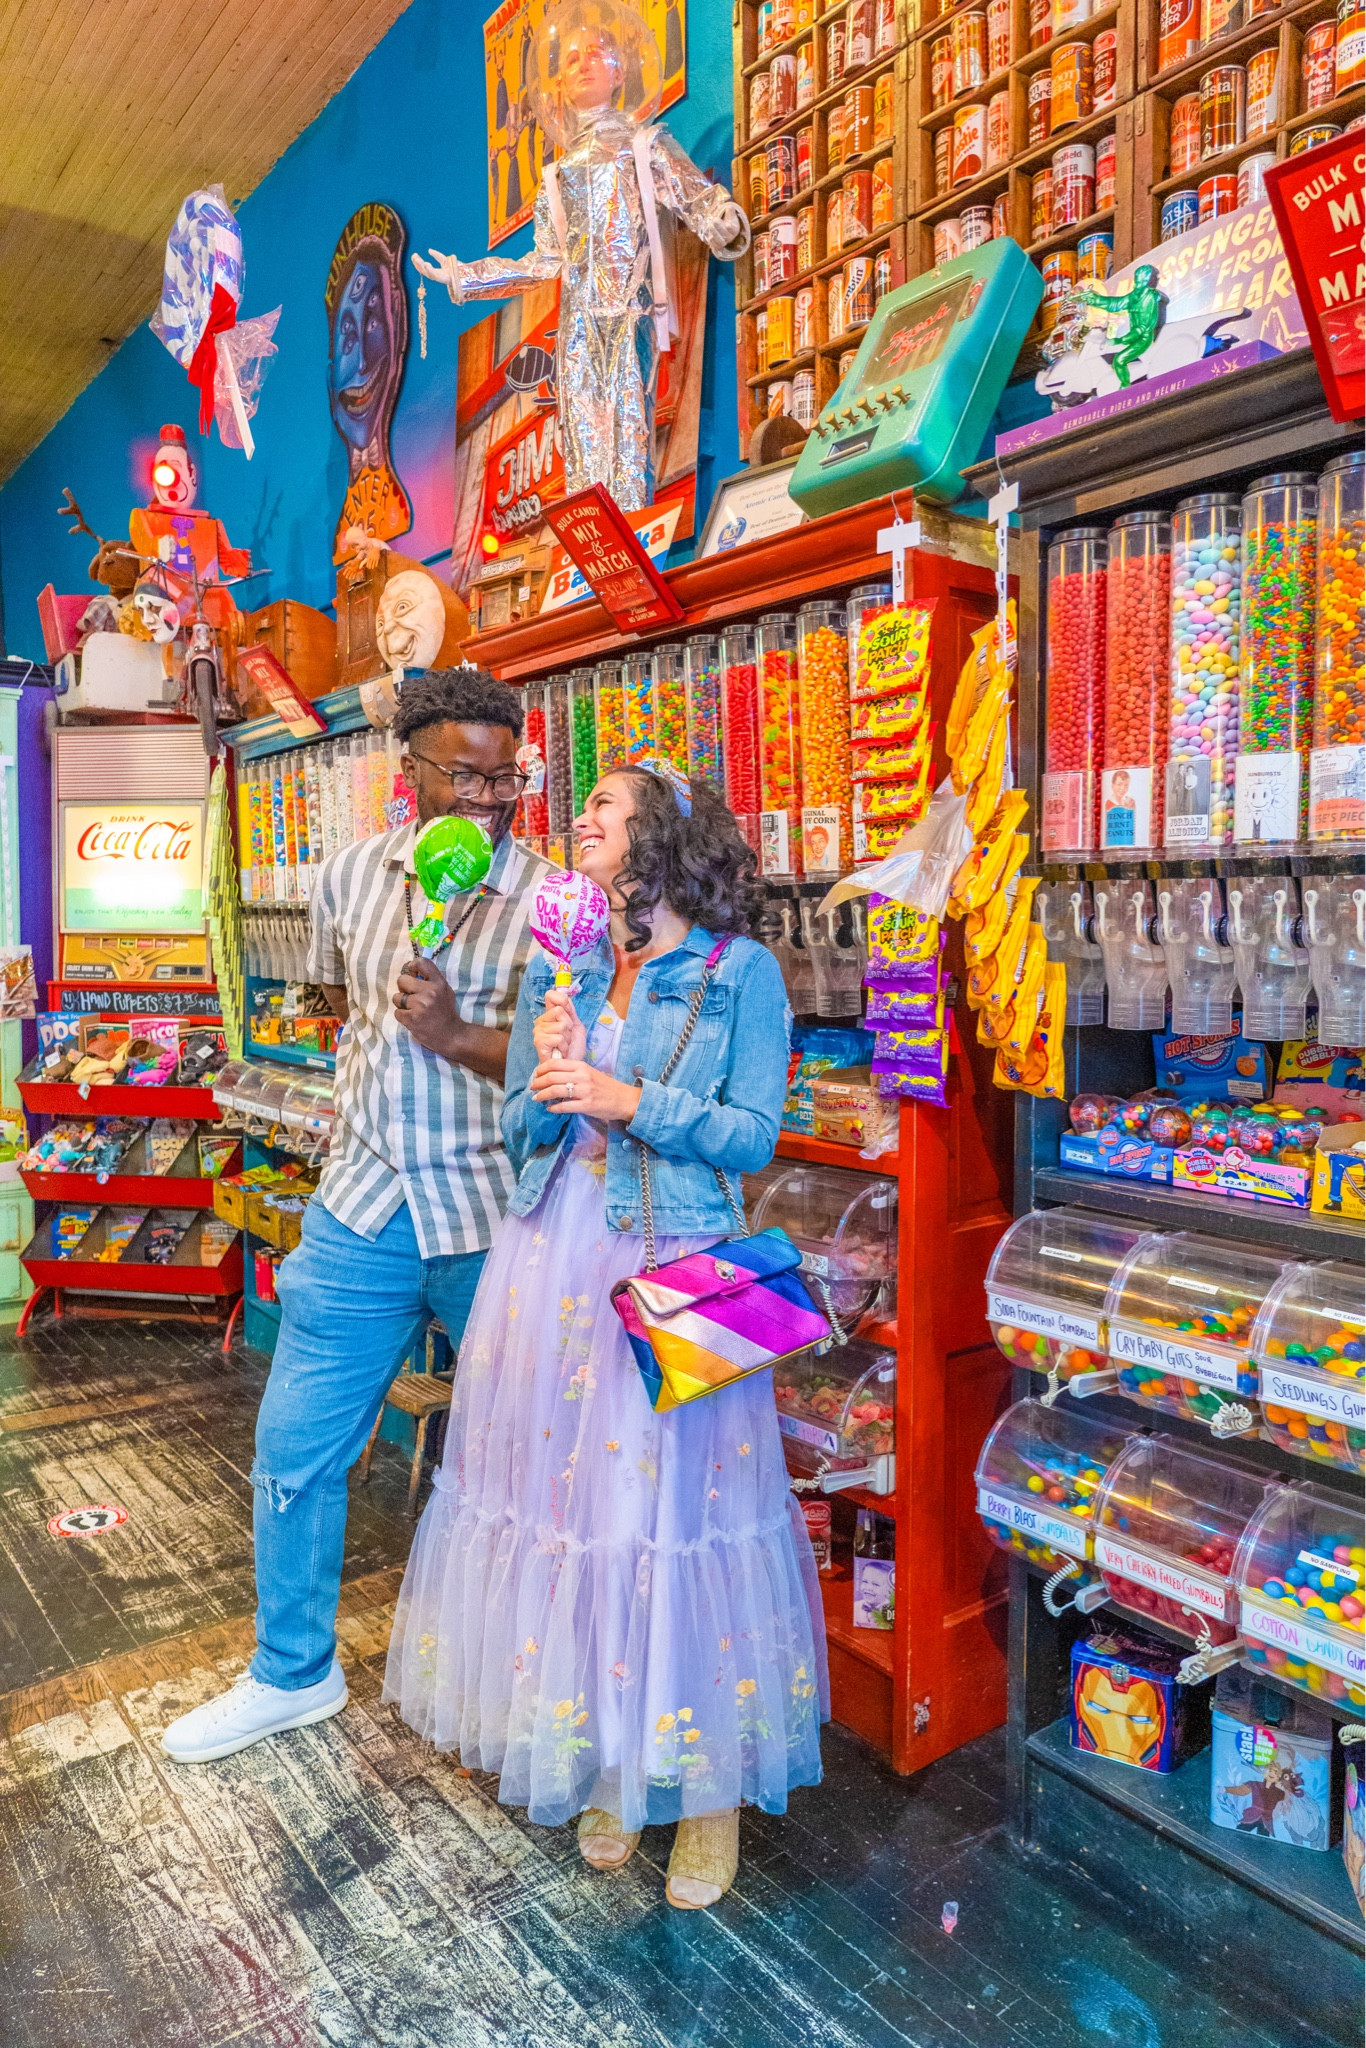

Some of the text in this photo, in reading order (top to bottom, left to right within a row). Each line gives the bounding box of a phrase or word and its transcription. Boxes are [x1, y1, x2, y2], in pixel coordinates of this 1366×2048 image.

[1311, 32, 1327, 49] TV
[1307, 71, 1332, 88] root
[1307, 83, 1333, 100] beer
[1292, 163, 1348, 212] BULK
[1162, 201, 1192, 227] OTSA
[325, 203, 394, 308] FUN HOUSE
[1211, 256, 1297, 312] MAR
[1063, 378, 1188, 431] REMOVABLE RIDER AND HELMET
[344, 473, 390, 528] ENTER
[556, 511, 575, 532] BULK
[572, 506, 601, 519] CANDY
[571, 520, 602, 545] MIX
[591, 540, 605, 557] &
[584, 550, 633, 579] MATCH
[627, 610, 658, 624] NO SAMPLING
[871, 628, 909, 651] SOUR
[867, 639, 909, 667] PATCH
[253, 667, 272, 680] MIX
[265, 686, 294, 701] MATCH
[1168, 826, 1208, 837] ALMONDS
[1169, 816, 1204, 827] JORDAN
[883, 915, 915, 931] SOUR
[880, 925, 917, 945] PATCH
[79, 991, 111, 1011] HAND
[113, 992, 159, 1014] PUPPETS
[1164, 1035, 1190, 1059] HOT
[1298, 1046, 1335, 1060] DUBBLE
[1300, 1049, 1337, 1067] BUBBLE
[1108, 1145, 1152, 1167] HOT SPORTS
[1186, 1158, 1212, 1167] DUBBLE
[1188, 1164, 1214, 1173] BUBBLE
[1224, 1180, 1248, 1188] $2.49
[994, 1298, 1017, 1319] SODA
[1016, 1303, 1056, 1328] FOUNTAIN
[1116, 1331, 1194, 1370] CRY BABY GUTS
[1194, 1350, 1213, 1364] SOUR
[1194, 1364, 1234, 1385] BUBBLEGUM
[1272, 1376, 1339, 1412] SEEDLINGS
[987, 1494, 1081, 1547] BERRY BLAST GUMBALLS
[1310, 1556, 1352, 1577] NO SAMPLING
[1104, 1546, 1225, 1610] VERY CHERRY FILLED GUMBALLS
[1252, 1612, 1344, 1665] COTTON CANDY
